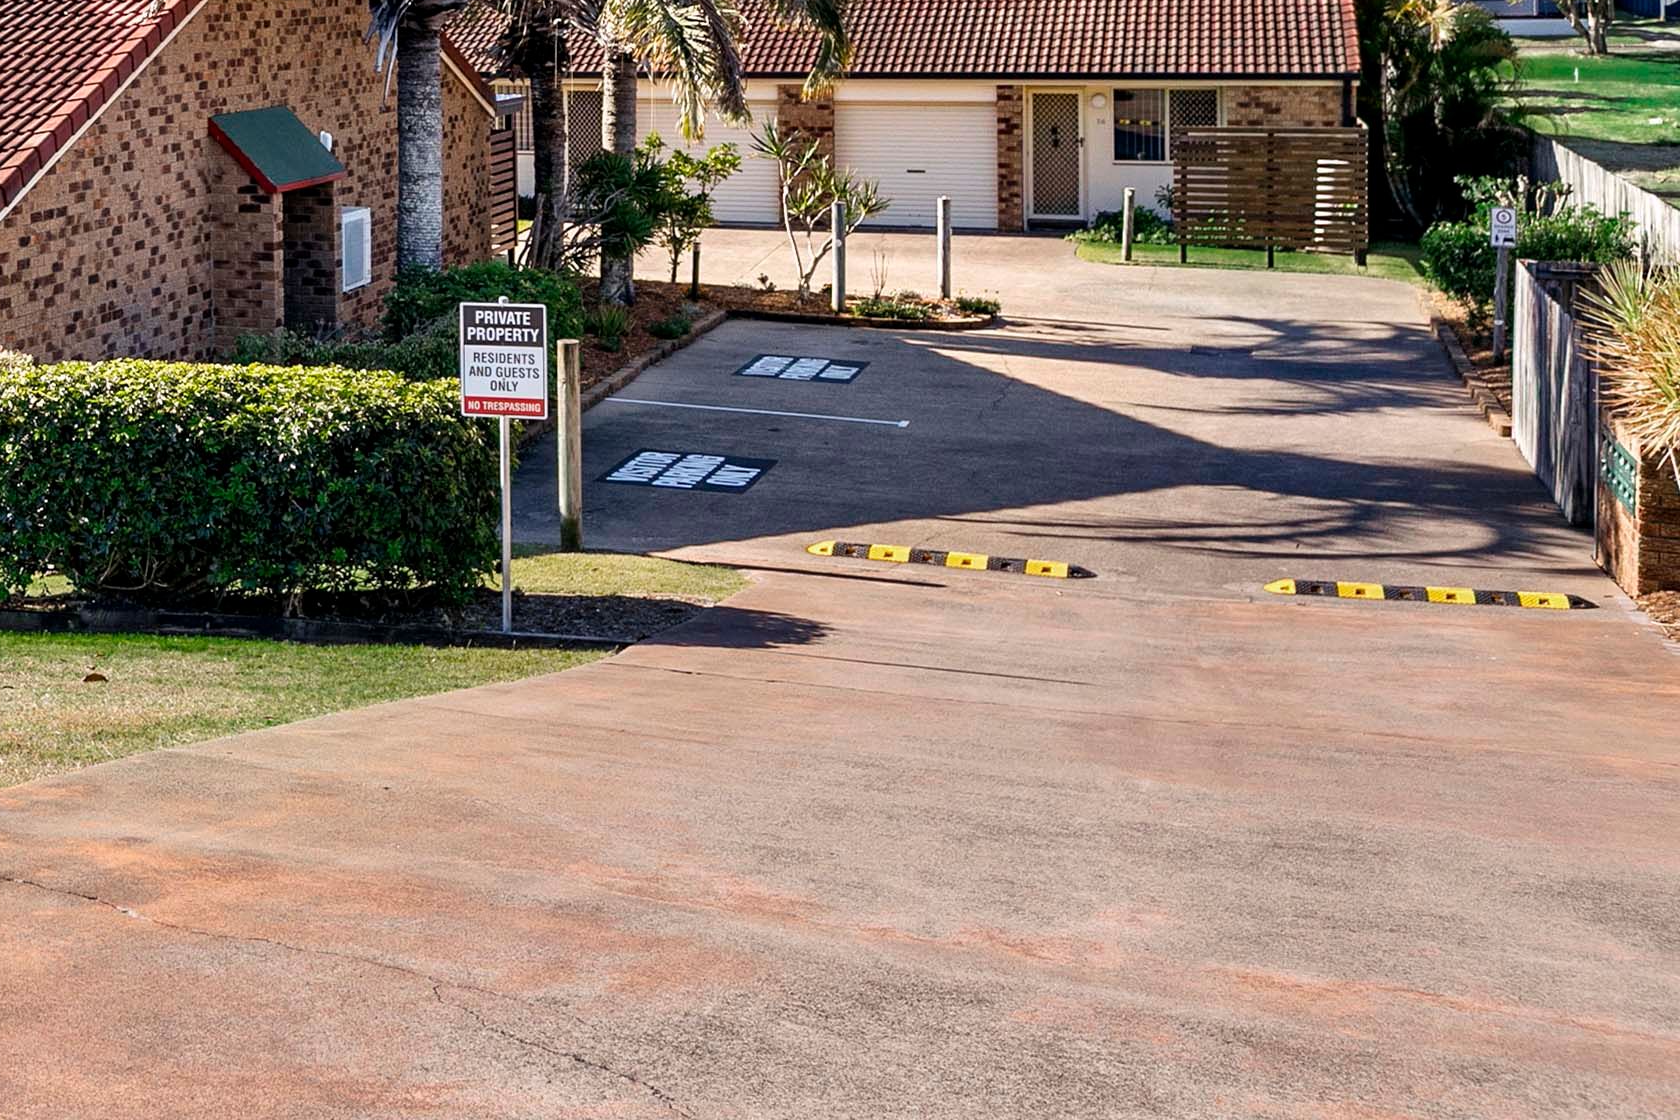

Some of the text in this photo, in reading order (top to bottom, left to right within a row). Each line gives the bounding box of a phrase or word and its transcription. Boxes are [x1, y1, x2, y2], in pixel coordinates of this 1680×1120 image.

[475, 310, 531, 326] PRIVATE
[467, 327, 540, 342] PROPERTY
[473, 352, 536, 365] RESIDENTS
[469, 366, 540, 379] AND GUESTS
[490, 380, 519, 392] ONLY
[468, 401, 541, 413] NO TRESPASSING
[606, 451, 681, 481] VISITOR
[652, 454, 726, 488] PARKING
[706, 464, 761, 487] ONLY
